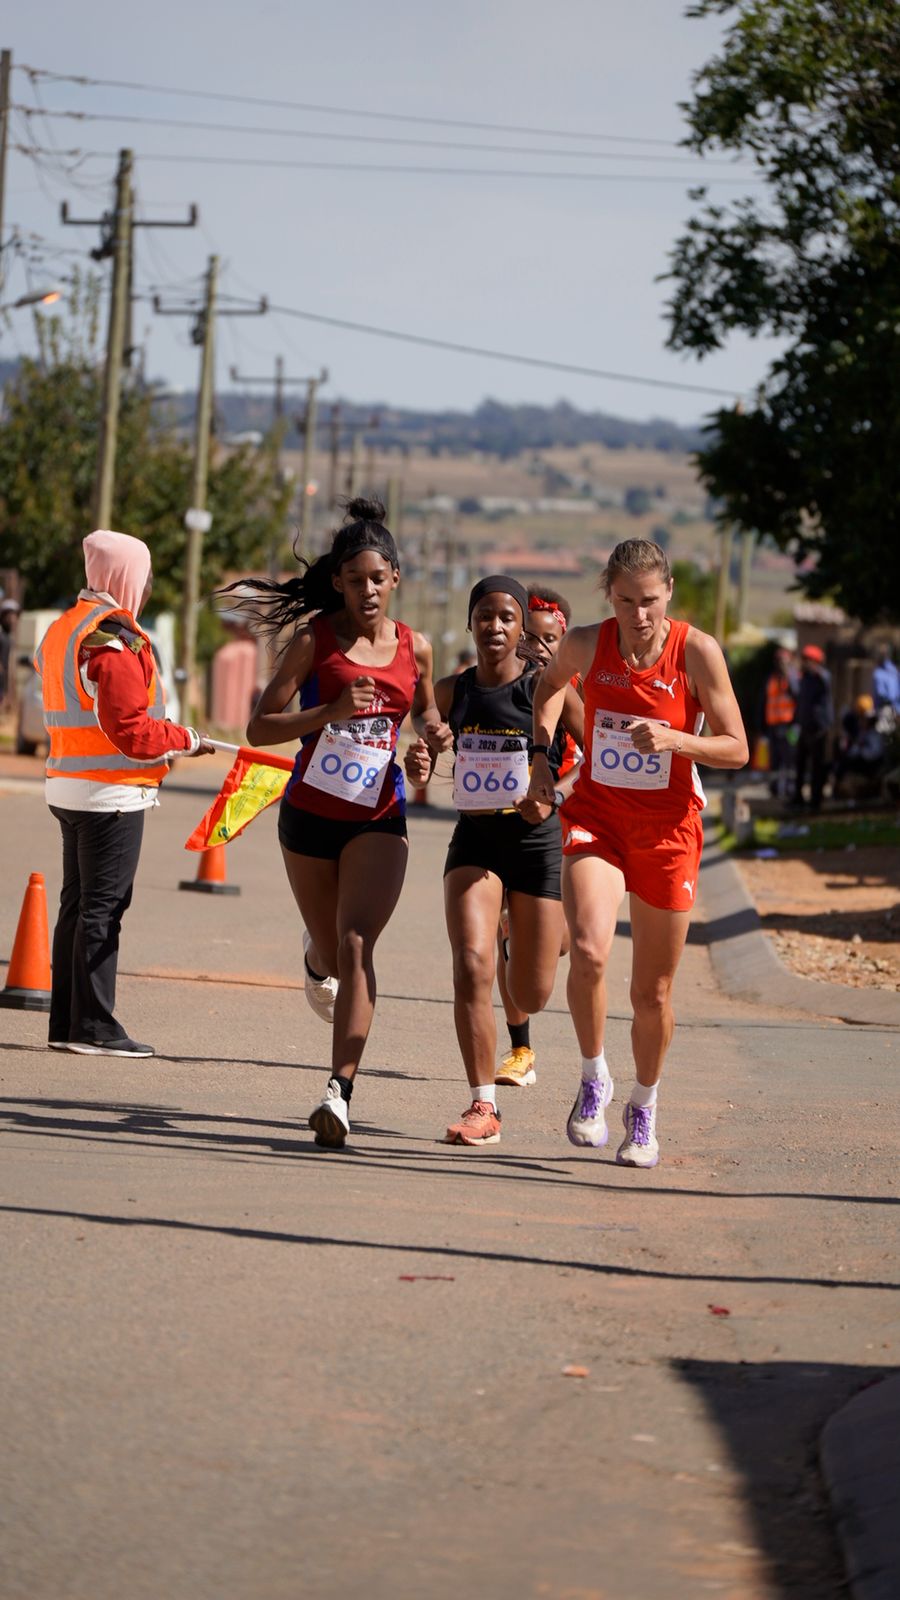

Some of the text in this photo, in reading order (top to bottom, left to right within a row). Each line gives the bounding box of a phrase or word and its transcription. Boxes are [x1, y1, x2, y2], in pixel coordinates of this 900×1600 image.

[478, 739, 497, 751] 2026
[321, 753, 379, 789] 008
[600, 748, 661, 775] 005
[462, 770, 519, 793] 066
